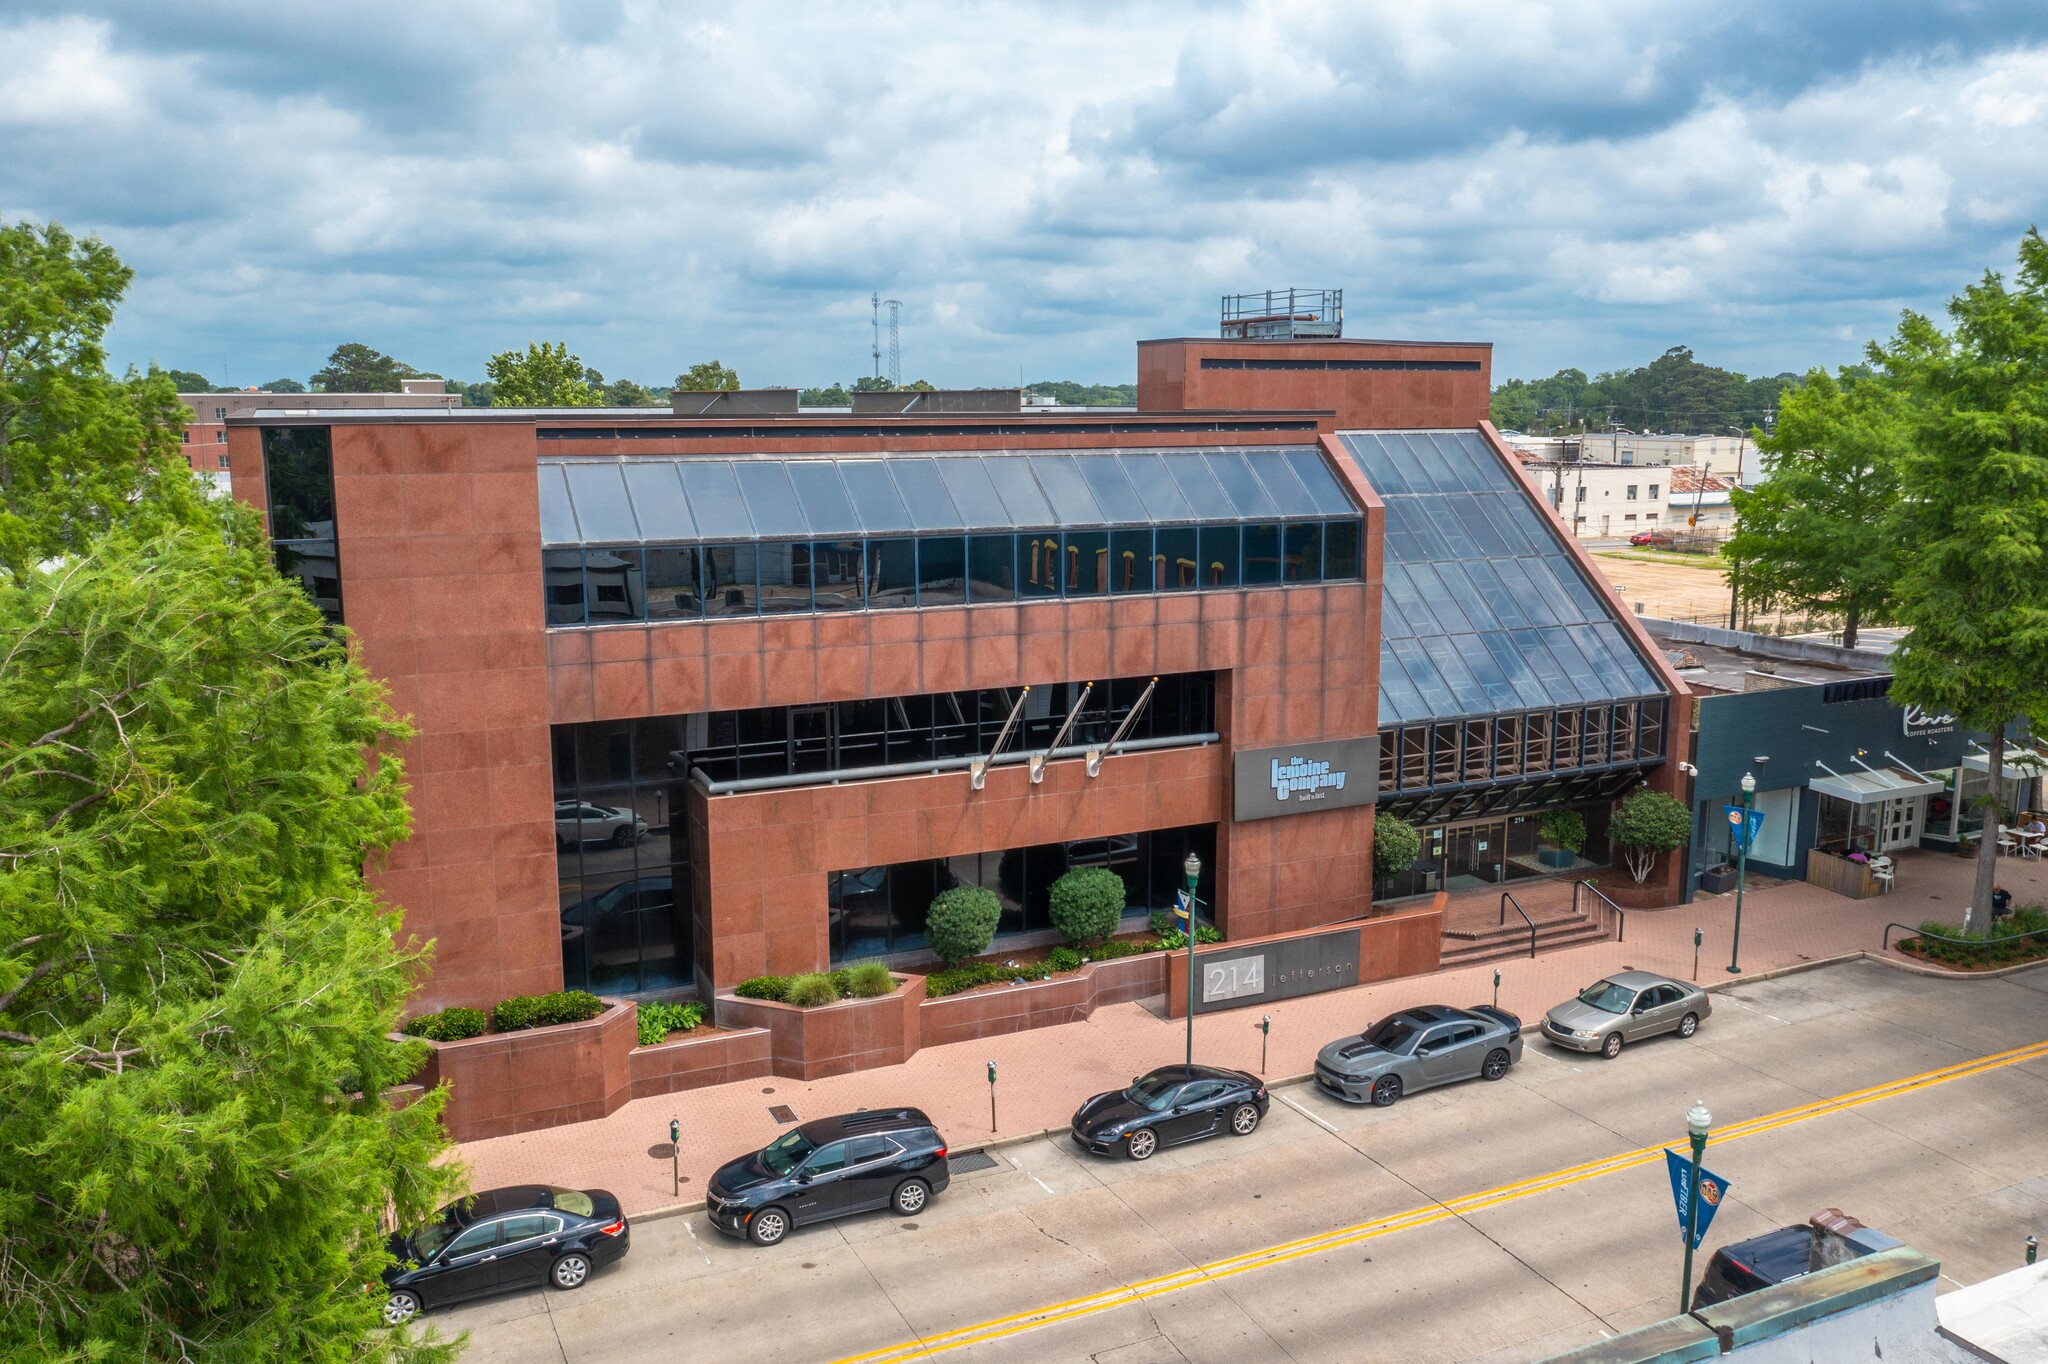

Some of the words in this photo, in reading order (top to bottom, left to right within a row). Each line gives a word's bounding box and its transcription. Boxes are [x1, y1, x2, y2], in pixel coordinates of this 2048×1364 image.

[1927, 726, 1953, 734] ROASTERS
[1290, 756, 1304, 765] the
[1514, 816, 1525, 824] 214
[1209, 962, 1258, 995] 214
[1271, 961, 1353, 987] jefferson
